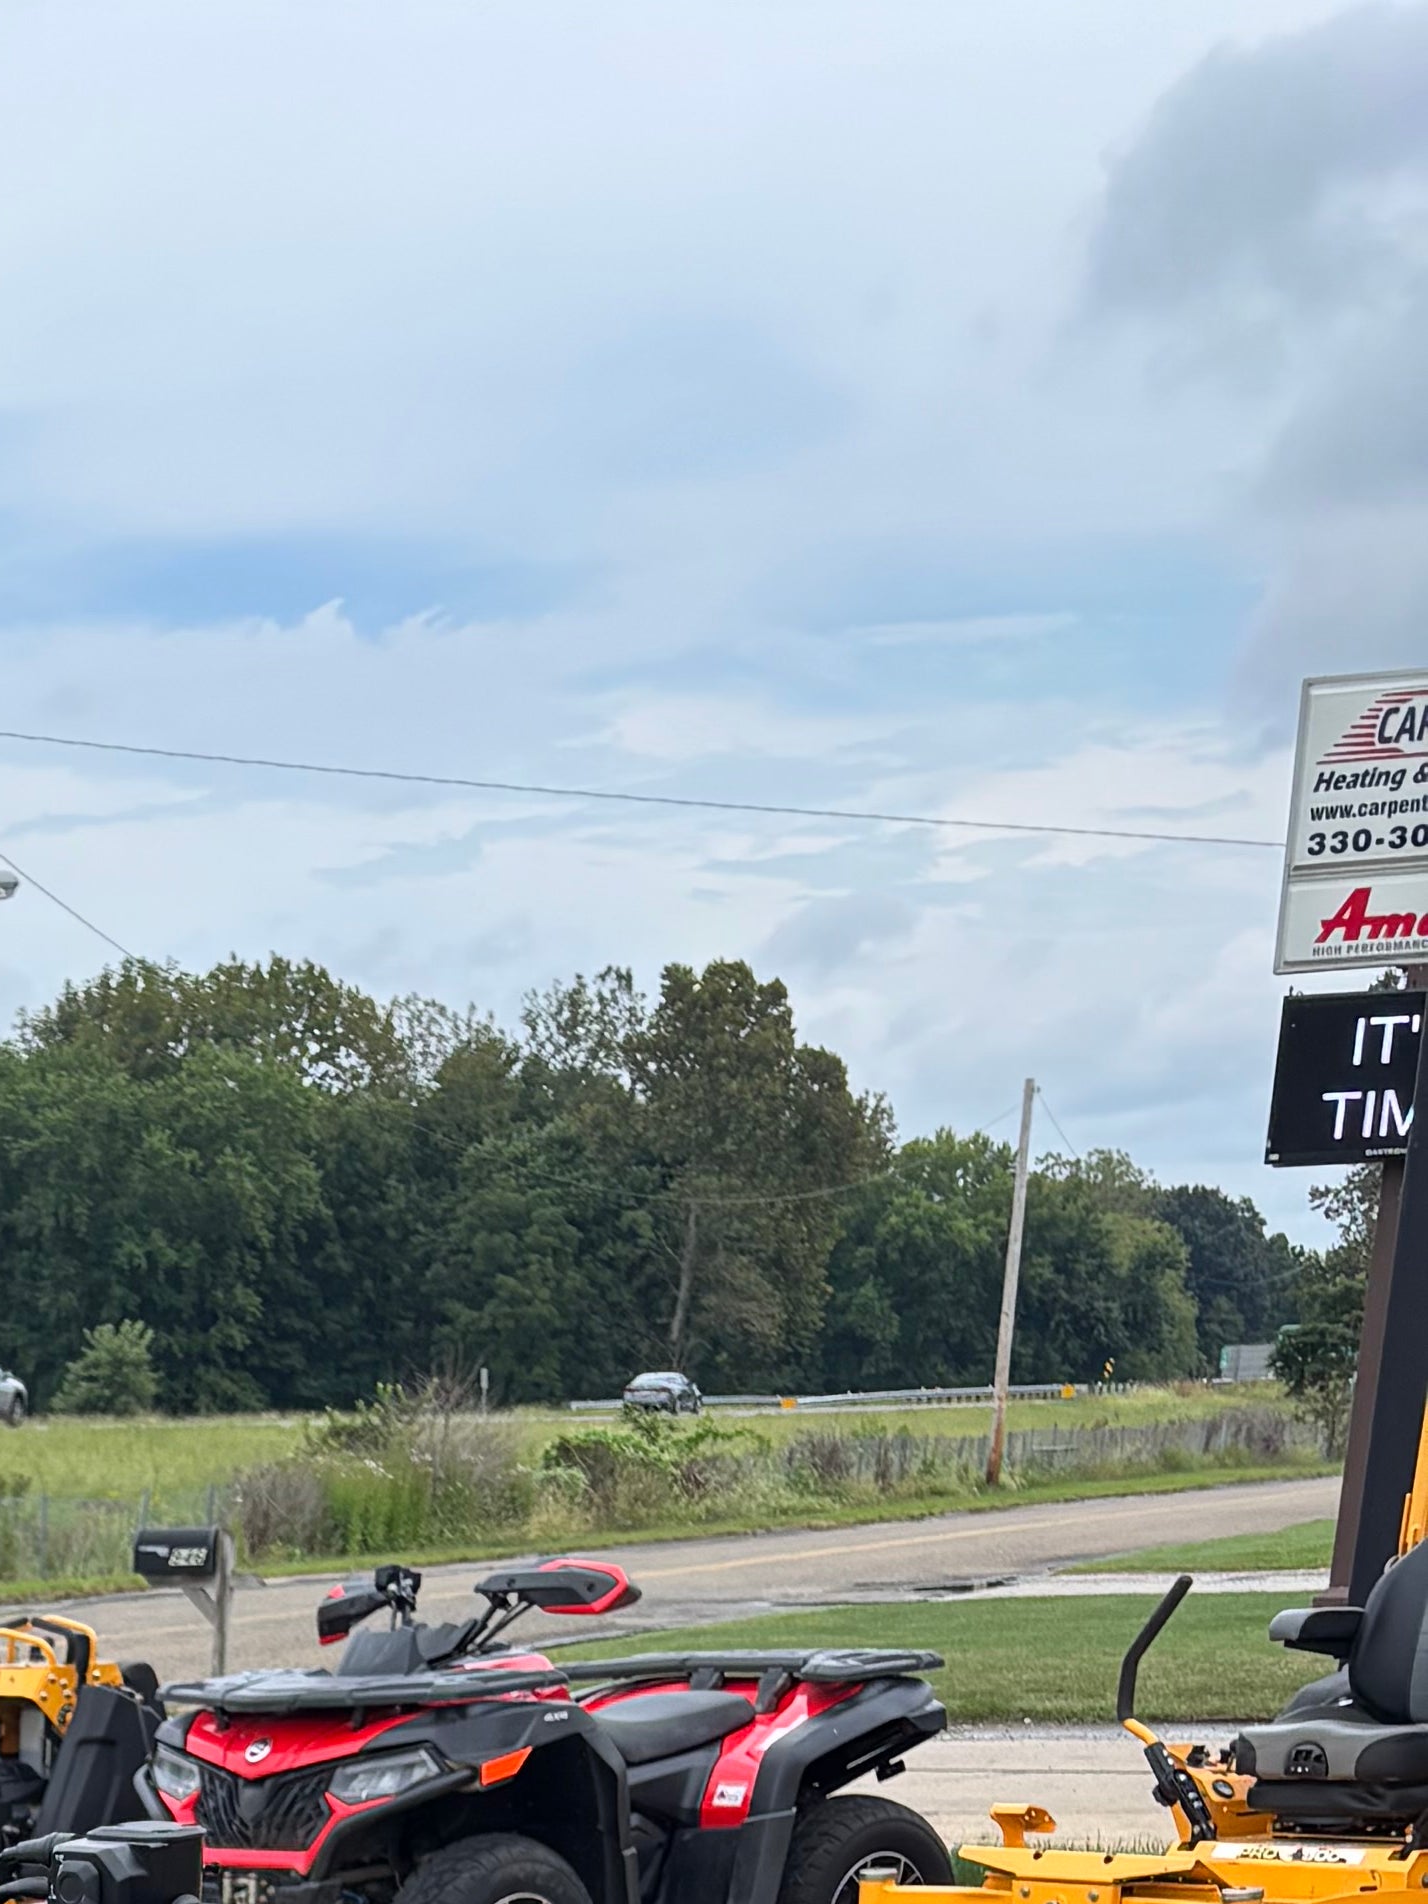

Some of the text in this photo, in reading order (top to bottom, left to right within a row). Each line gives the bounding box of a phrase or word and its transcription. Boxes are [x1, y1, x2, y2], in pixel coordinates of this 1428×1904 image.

[1313, 767, 1407, 793] Heating
[1307, 824, 1428, 856] 330-30
[1312, 945, 1342, 957] HIGH
